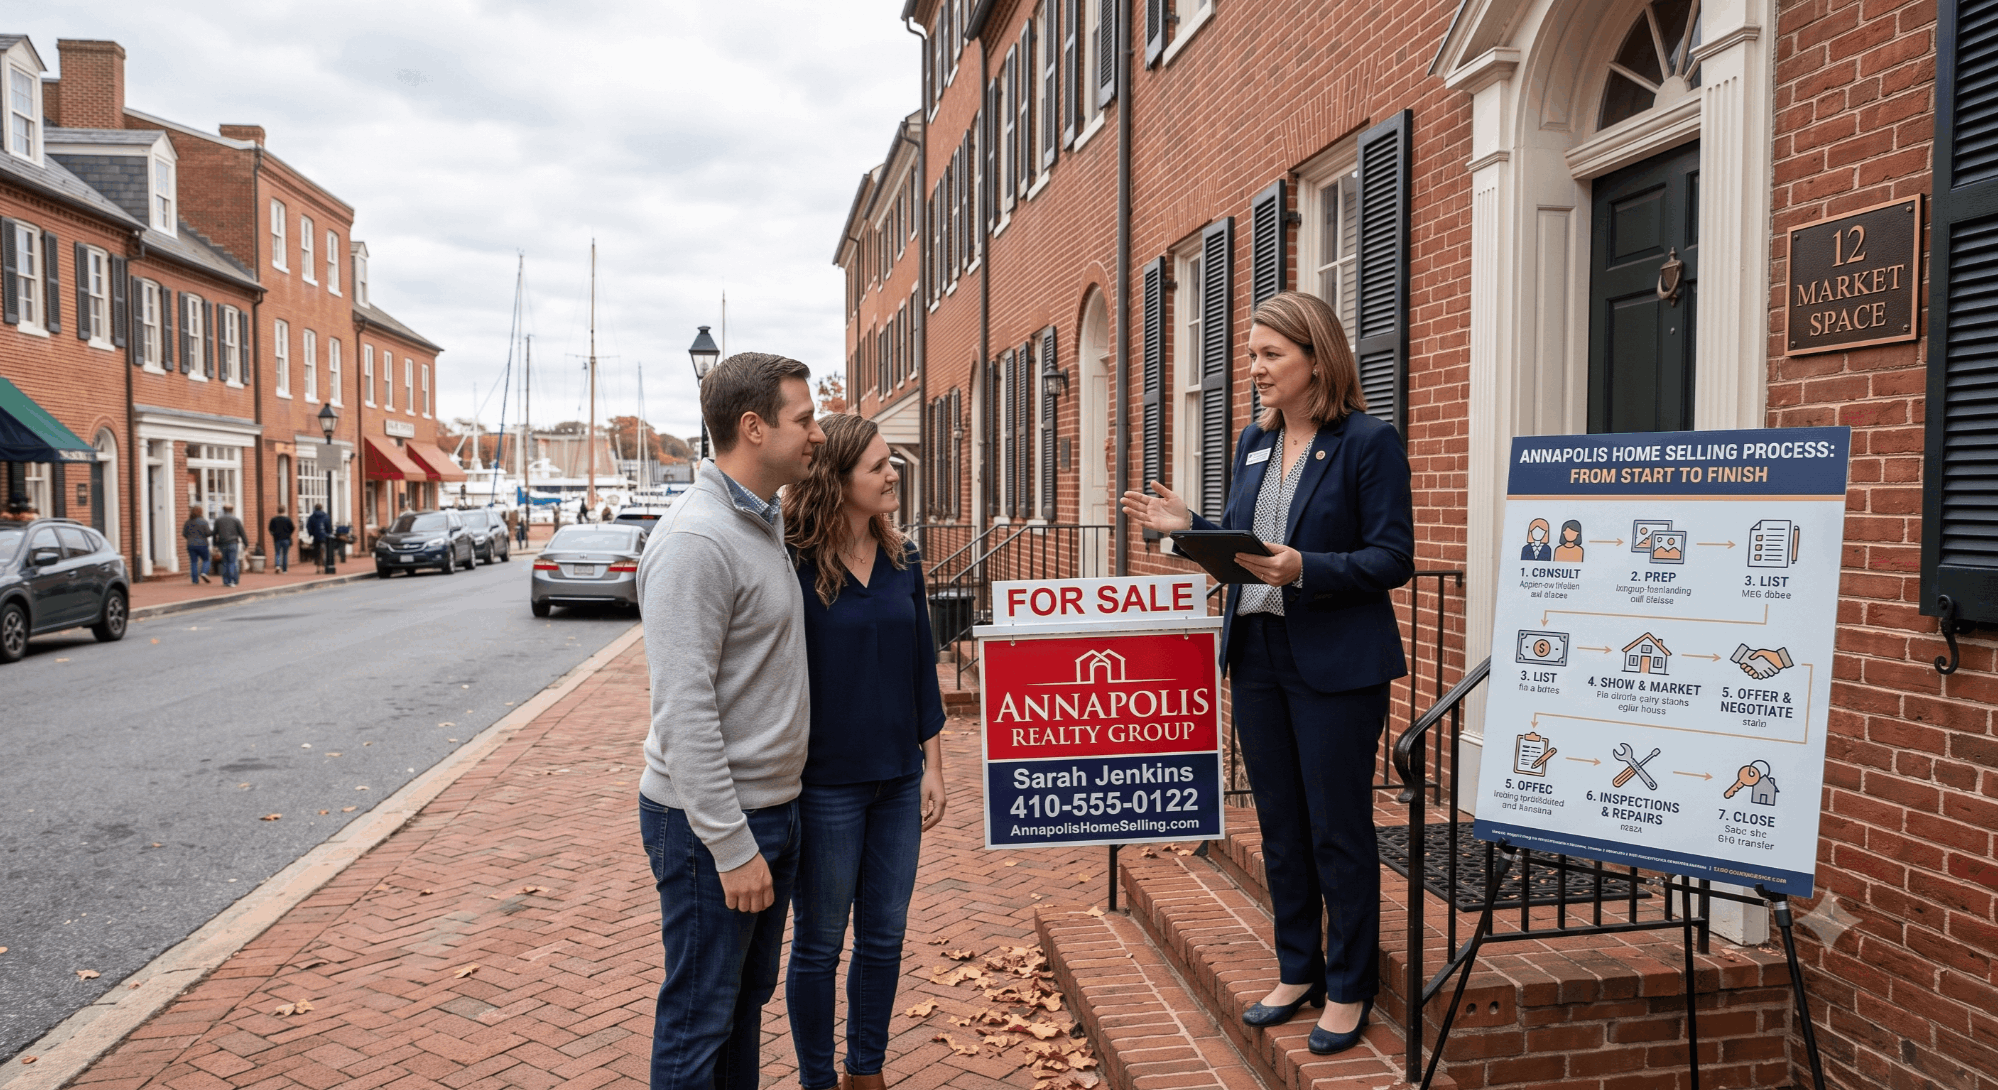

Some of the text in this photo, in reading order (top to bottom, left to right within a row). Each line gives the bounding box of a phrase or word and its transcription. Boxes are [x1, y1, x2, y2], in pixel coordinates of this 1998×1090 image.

[1832, 225, 1867, 267] 12
[1796, 264, 1905, 307] MARKET
[1810, 302, 1887, 337] SPACE
[1519, 441, 1835, 464] ANNAPOLIS HOME SELLING PROCESS:
[1570, 466, 1768, 484] FROM START TO FINISH
[1520, 567, 1529, 577] 1.
[1630, 571, 1676, 582] 2. PREP
[1744, 575, 1789, 587] 3. LIST
[1007, 583, 1194, 618] FOR SALE
[1520, 670, 1558, 683] 3. LIST
[1588, 676, 1702, 696] 4. SHOW & MARKET
[1721, 686, 1792, 704] 5. OFFER &
[993, 688, 1209, 723] ANNAPOLIS
[1720, 701, 1794, 719] NEGOTIATE
[1011, 721, 1195, 747] REALTY GROUP
[1013, 763, 1194, 789] Sarah Jenkins
[1505, 778, 1553, 795] 5. OFFEC
[1010, 788, 1199, 819] 410-555-0122
[1586, 790, 1680, 813] 6. INSPECTIONS
[1601, 806, 1663, 825] & REPAIRS
[1718, 808, 1776, 828] 7. CLOSE
[1010, 819, 1199, 838] AnnapolisHomeSelling.com
